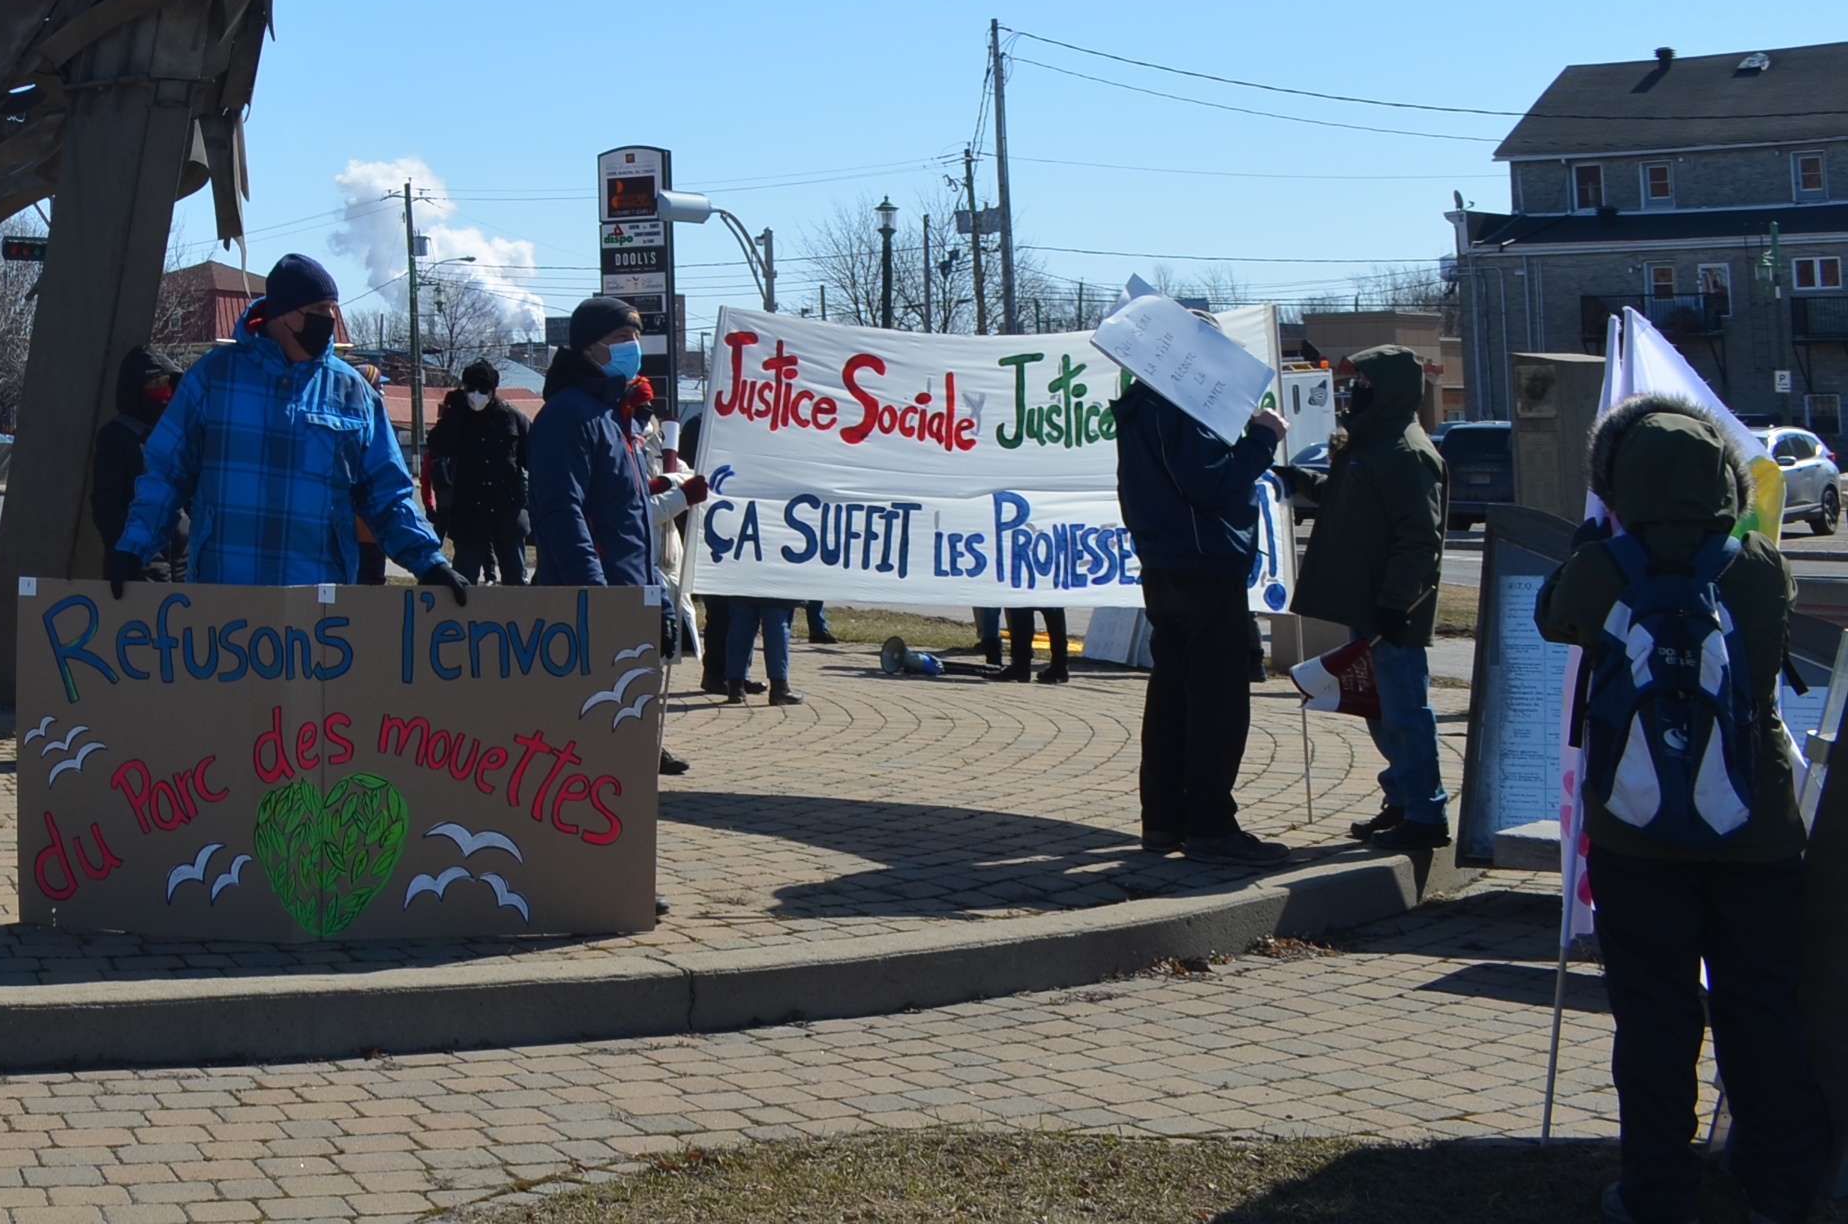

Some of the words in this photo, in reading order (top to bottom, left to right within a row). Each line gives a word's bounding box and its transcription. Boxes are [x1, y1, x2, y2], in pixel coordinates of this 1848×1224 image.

[714, 330, 837, 432] Justice
[839, 353, 977, 452] Sociale
[781, 492, 922, 579] SUFFIT
[933, 531, 988, 578] LES
[993, 490, 1142, 590] PROMESSE
[42, 592, 353, 703] Refusons
[401, 589, 592, 684] l'envol
[33, 811, 124, 901] du
[111, 754, 230, 835] Parc
[252, 705, 355, 784] des
[377, 713, 623, 846] mouettes
